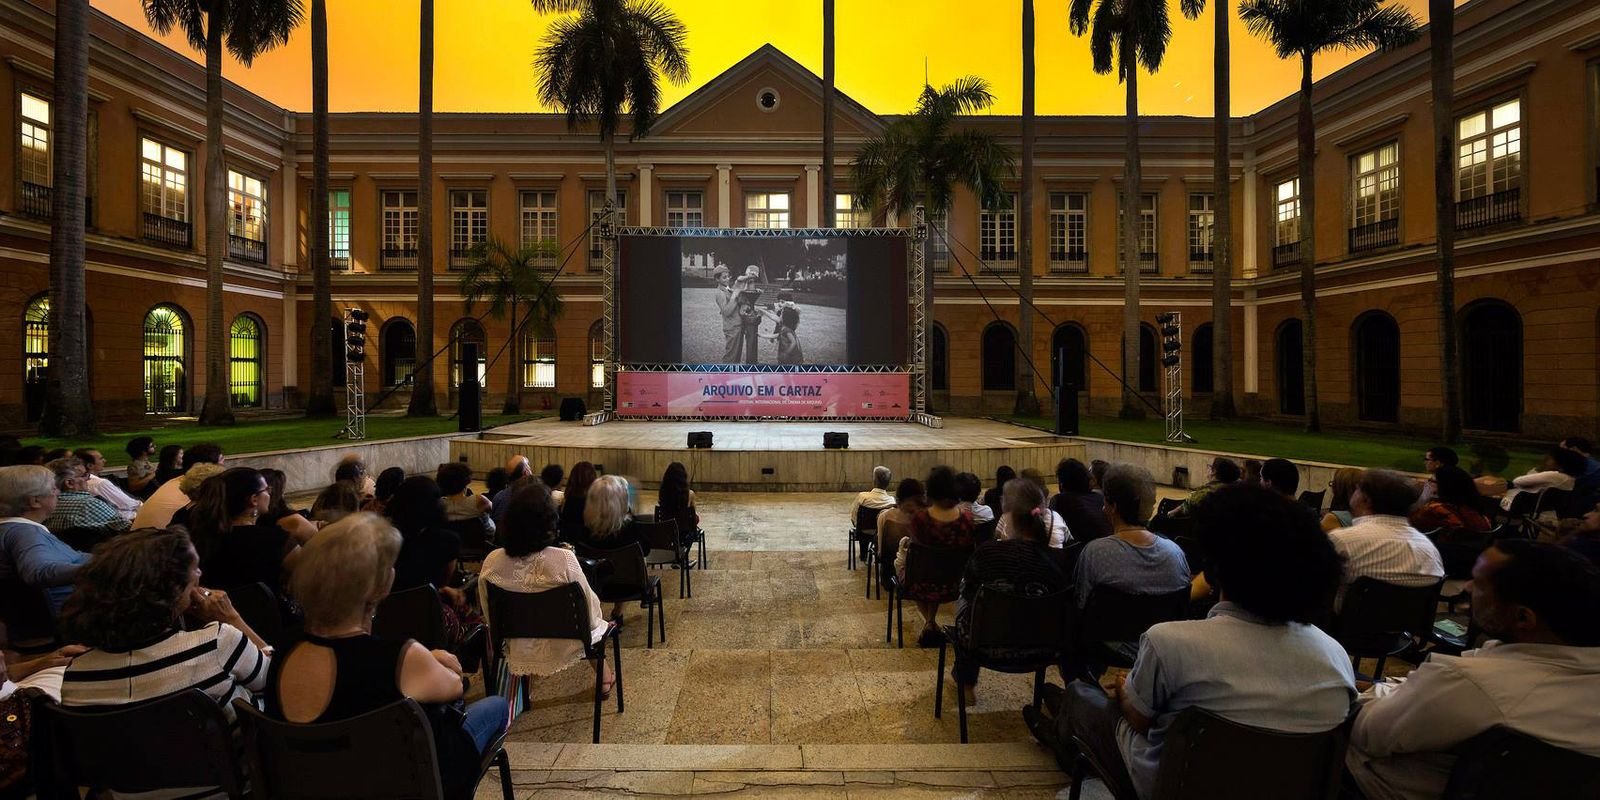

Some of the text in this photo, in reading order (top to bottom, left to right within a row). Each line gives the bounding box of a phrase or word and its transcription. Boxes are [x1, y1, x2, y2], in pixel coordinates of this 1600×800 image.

[703, 385, 822, 398] ARQUIVO EM CARTAZ
